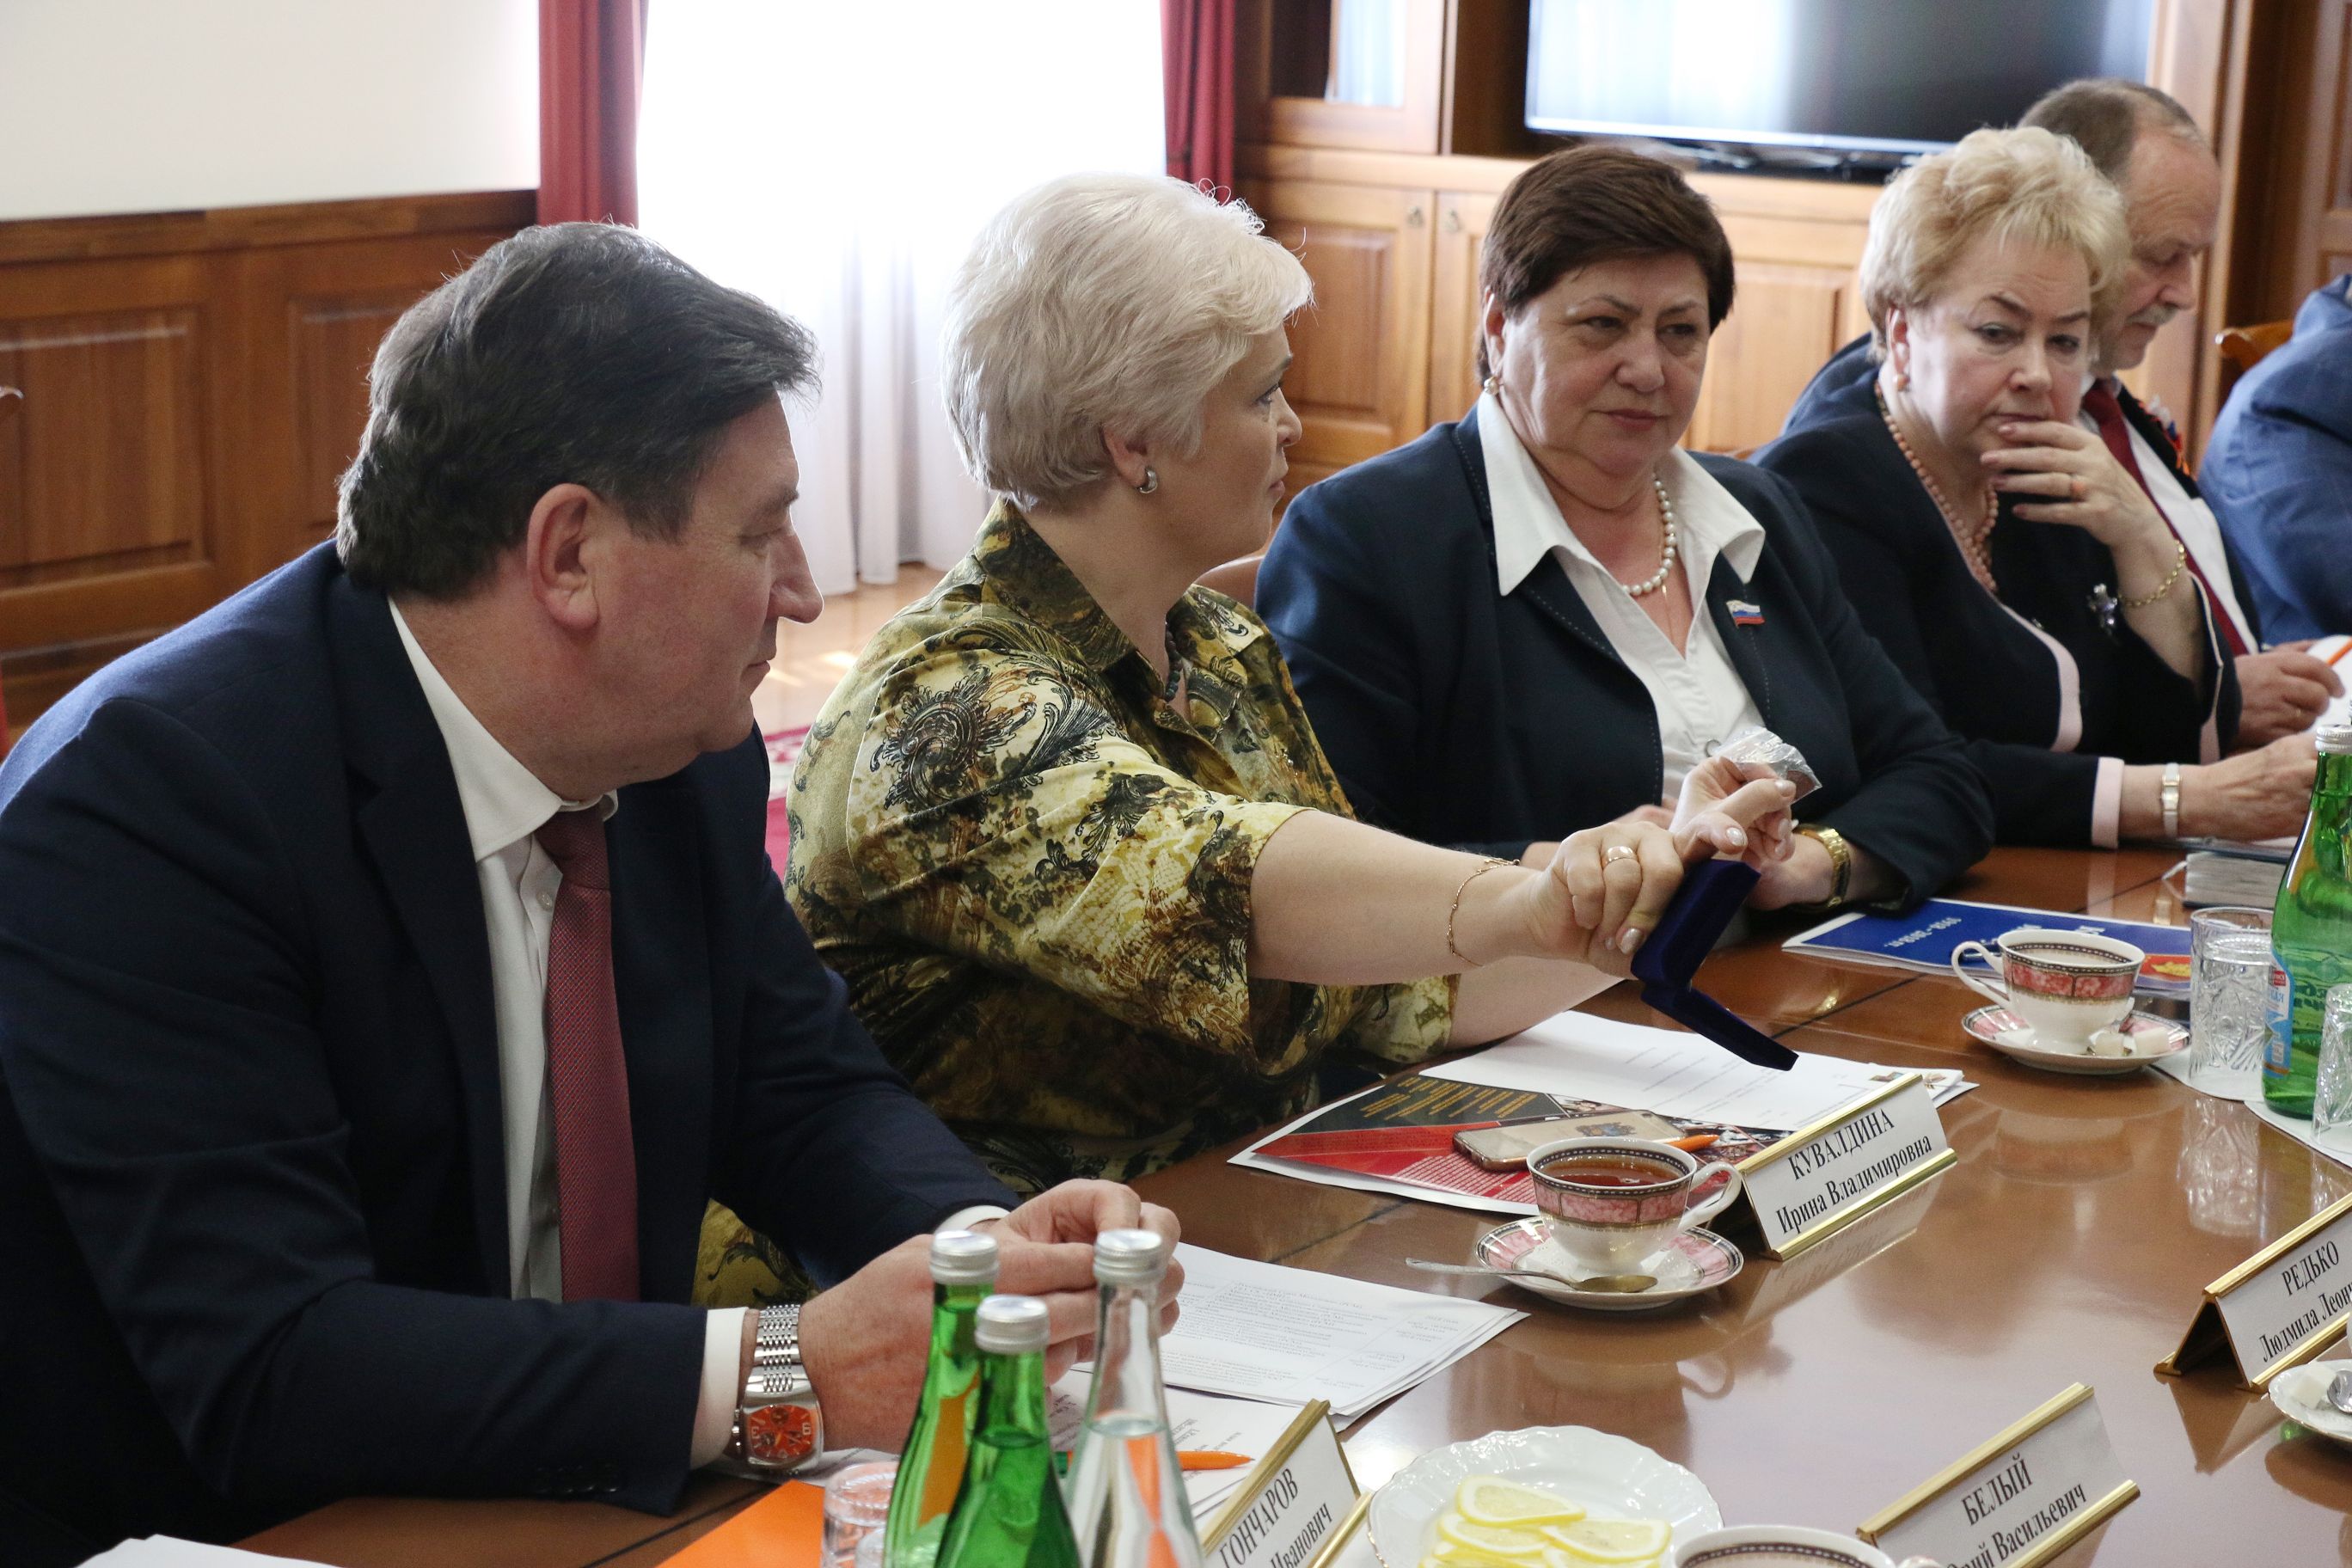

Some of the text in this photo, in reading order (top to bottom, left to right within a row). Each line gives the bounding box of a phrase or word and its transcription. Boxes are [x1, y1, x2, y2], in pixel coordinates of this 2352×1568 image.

[1788, 1107, 1896, 1180] КУВАЛДИНА
[1776, 1136, 1932, 1234] Ирина Владимировна
[2282, 1240, 2339, 1296] РЕДЬКО
[2259, 1308, 2320, 1363] Людмила
[1219, 1467, 1299, 1568] ГОНЧАРОВ
[1961, 1452, 2033, 1526] БЕЛЫЙ
[1992, 1483, 2087, 1562] Васильевич
